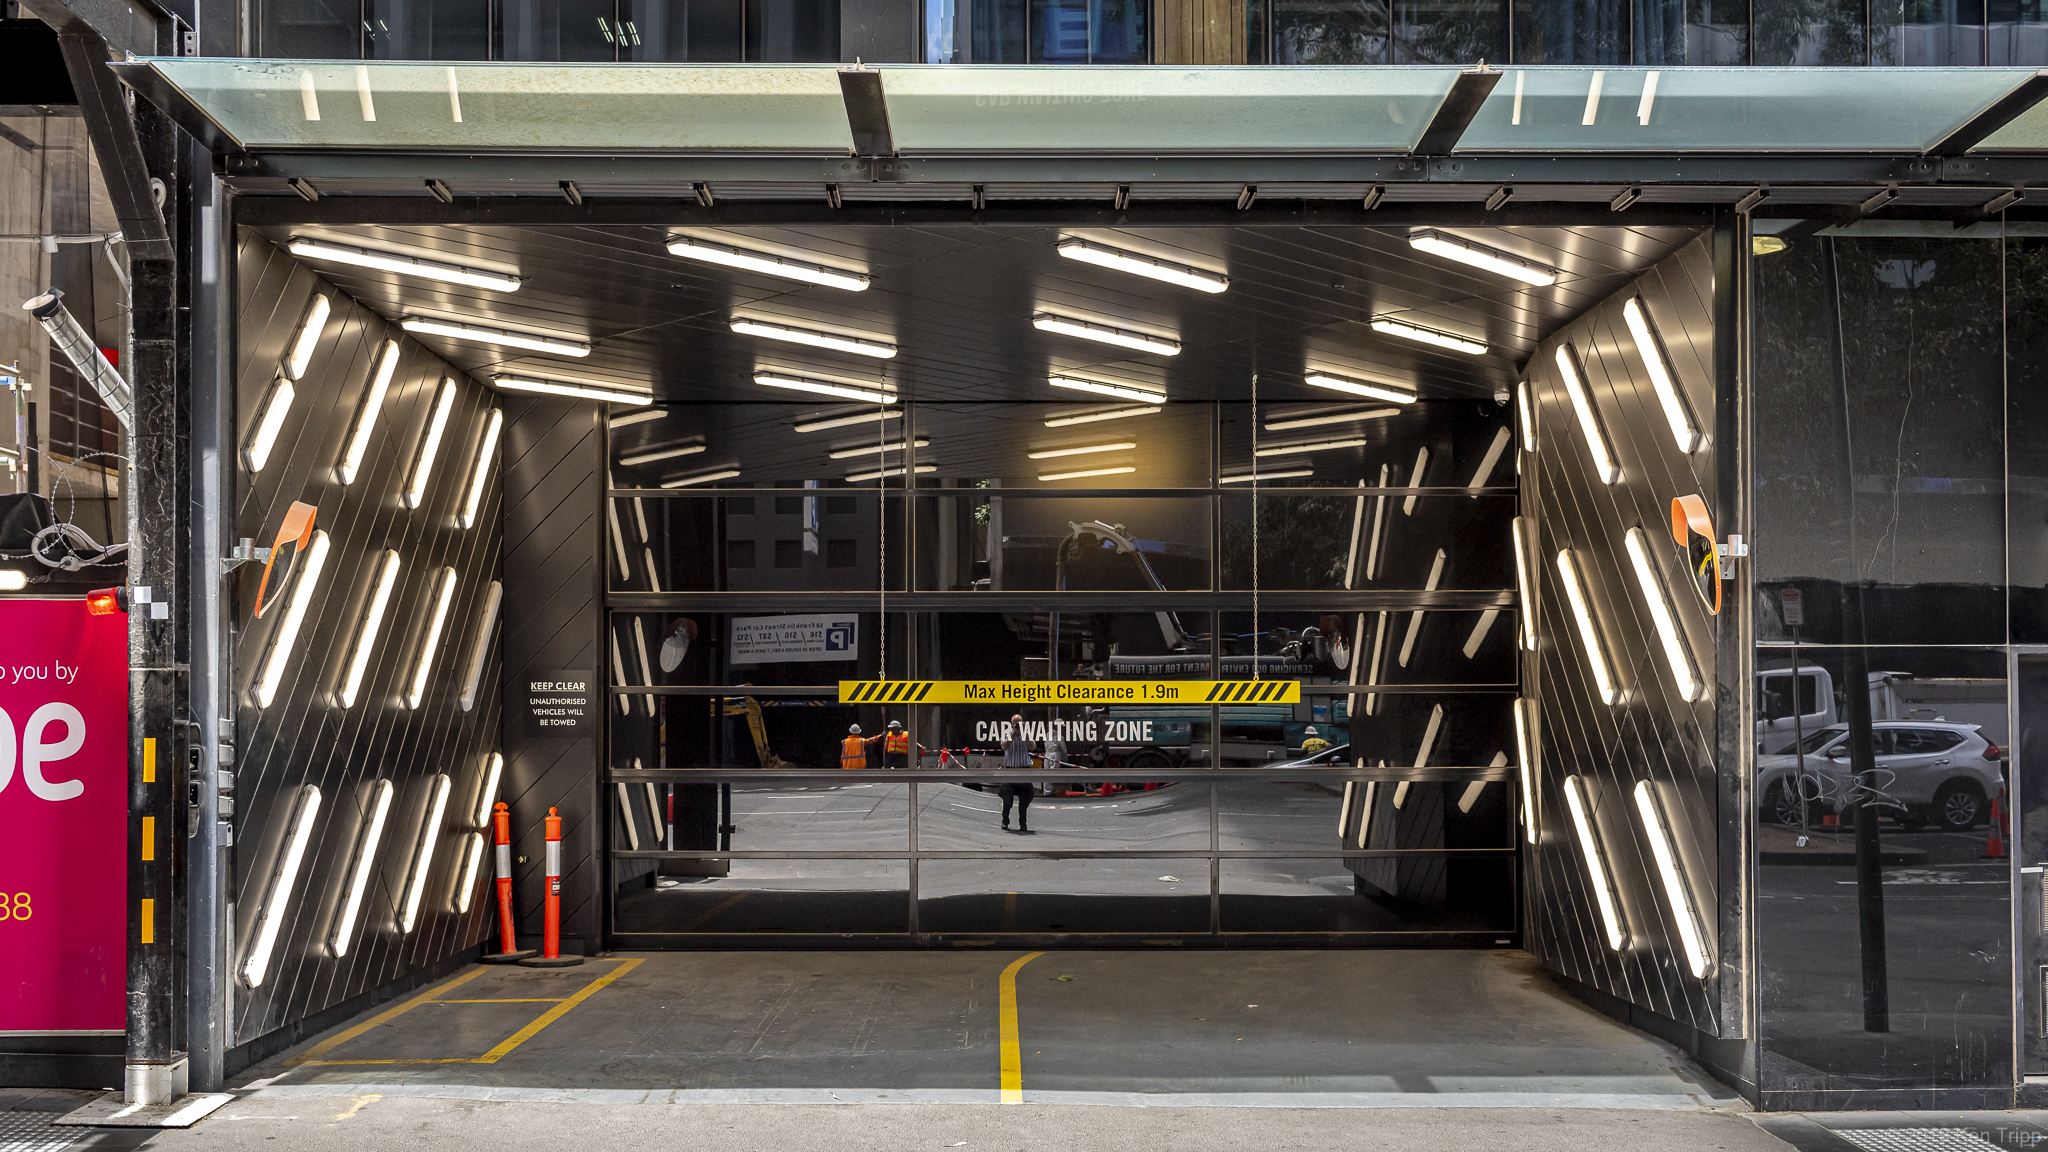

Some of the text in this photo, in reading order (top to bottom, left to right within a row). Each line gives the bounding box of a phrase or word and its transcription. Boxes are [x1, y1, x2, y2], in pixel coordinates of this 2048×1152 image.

[12, 665, 48, 684] you
[56, 660, 79, 684] by
[530, 682, 586, 690] KEEP CLEAR
[964, 683, 1179, 702] Max Height Clearance 1.9m
[975, 721, 1153, 742] CAR WAITING ZONE
[0, 701, 86, 801] e
